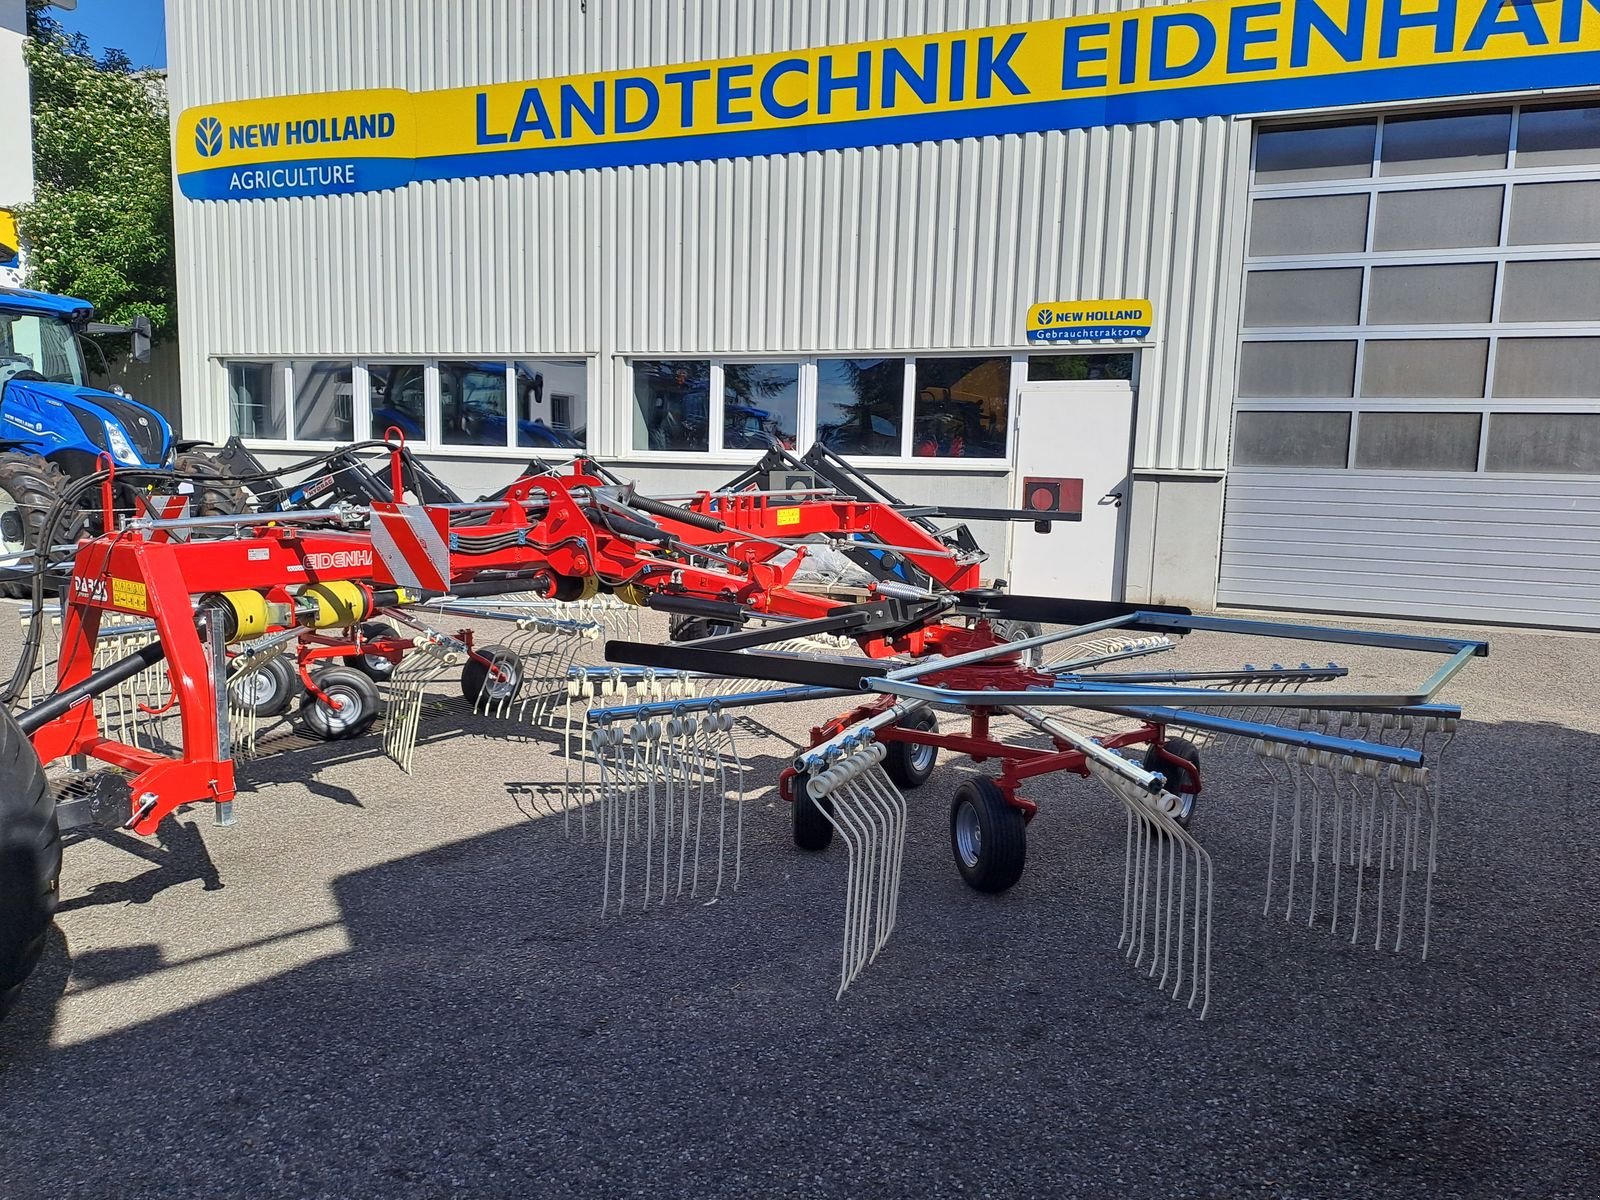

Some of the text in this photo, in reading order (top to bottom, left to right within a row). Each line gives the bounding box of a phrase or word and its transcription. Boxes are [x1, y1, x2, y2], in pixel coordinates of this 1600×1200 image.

[476, 31, 1030, 145] LANDTECHNIK
[229, 112, 395, 150] NEW HOLLAND
[229, 164, 355, 190] AGRICULTURE
[1056, 310, 1142, 322] NEW HOLLAND
[1036, 328, 1142, 339] Gebrauchttraktore
